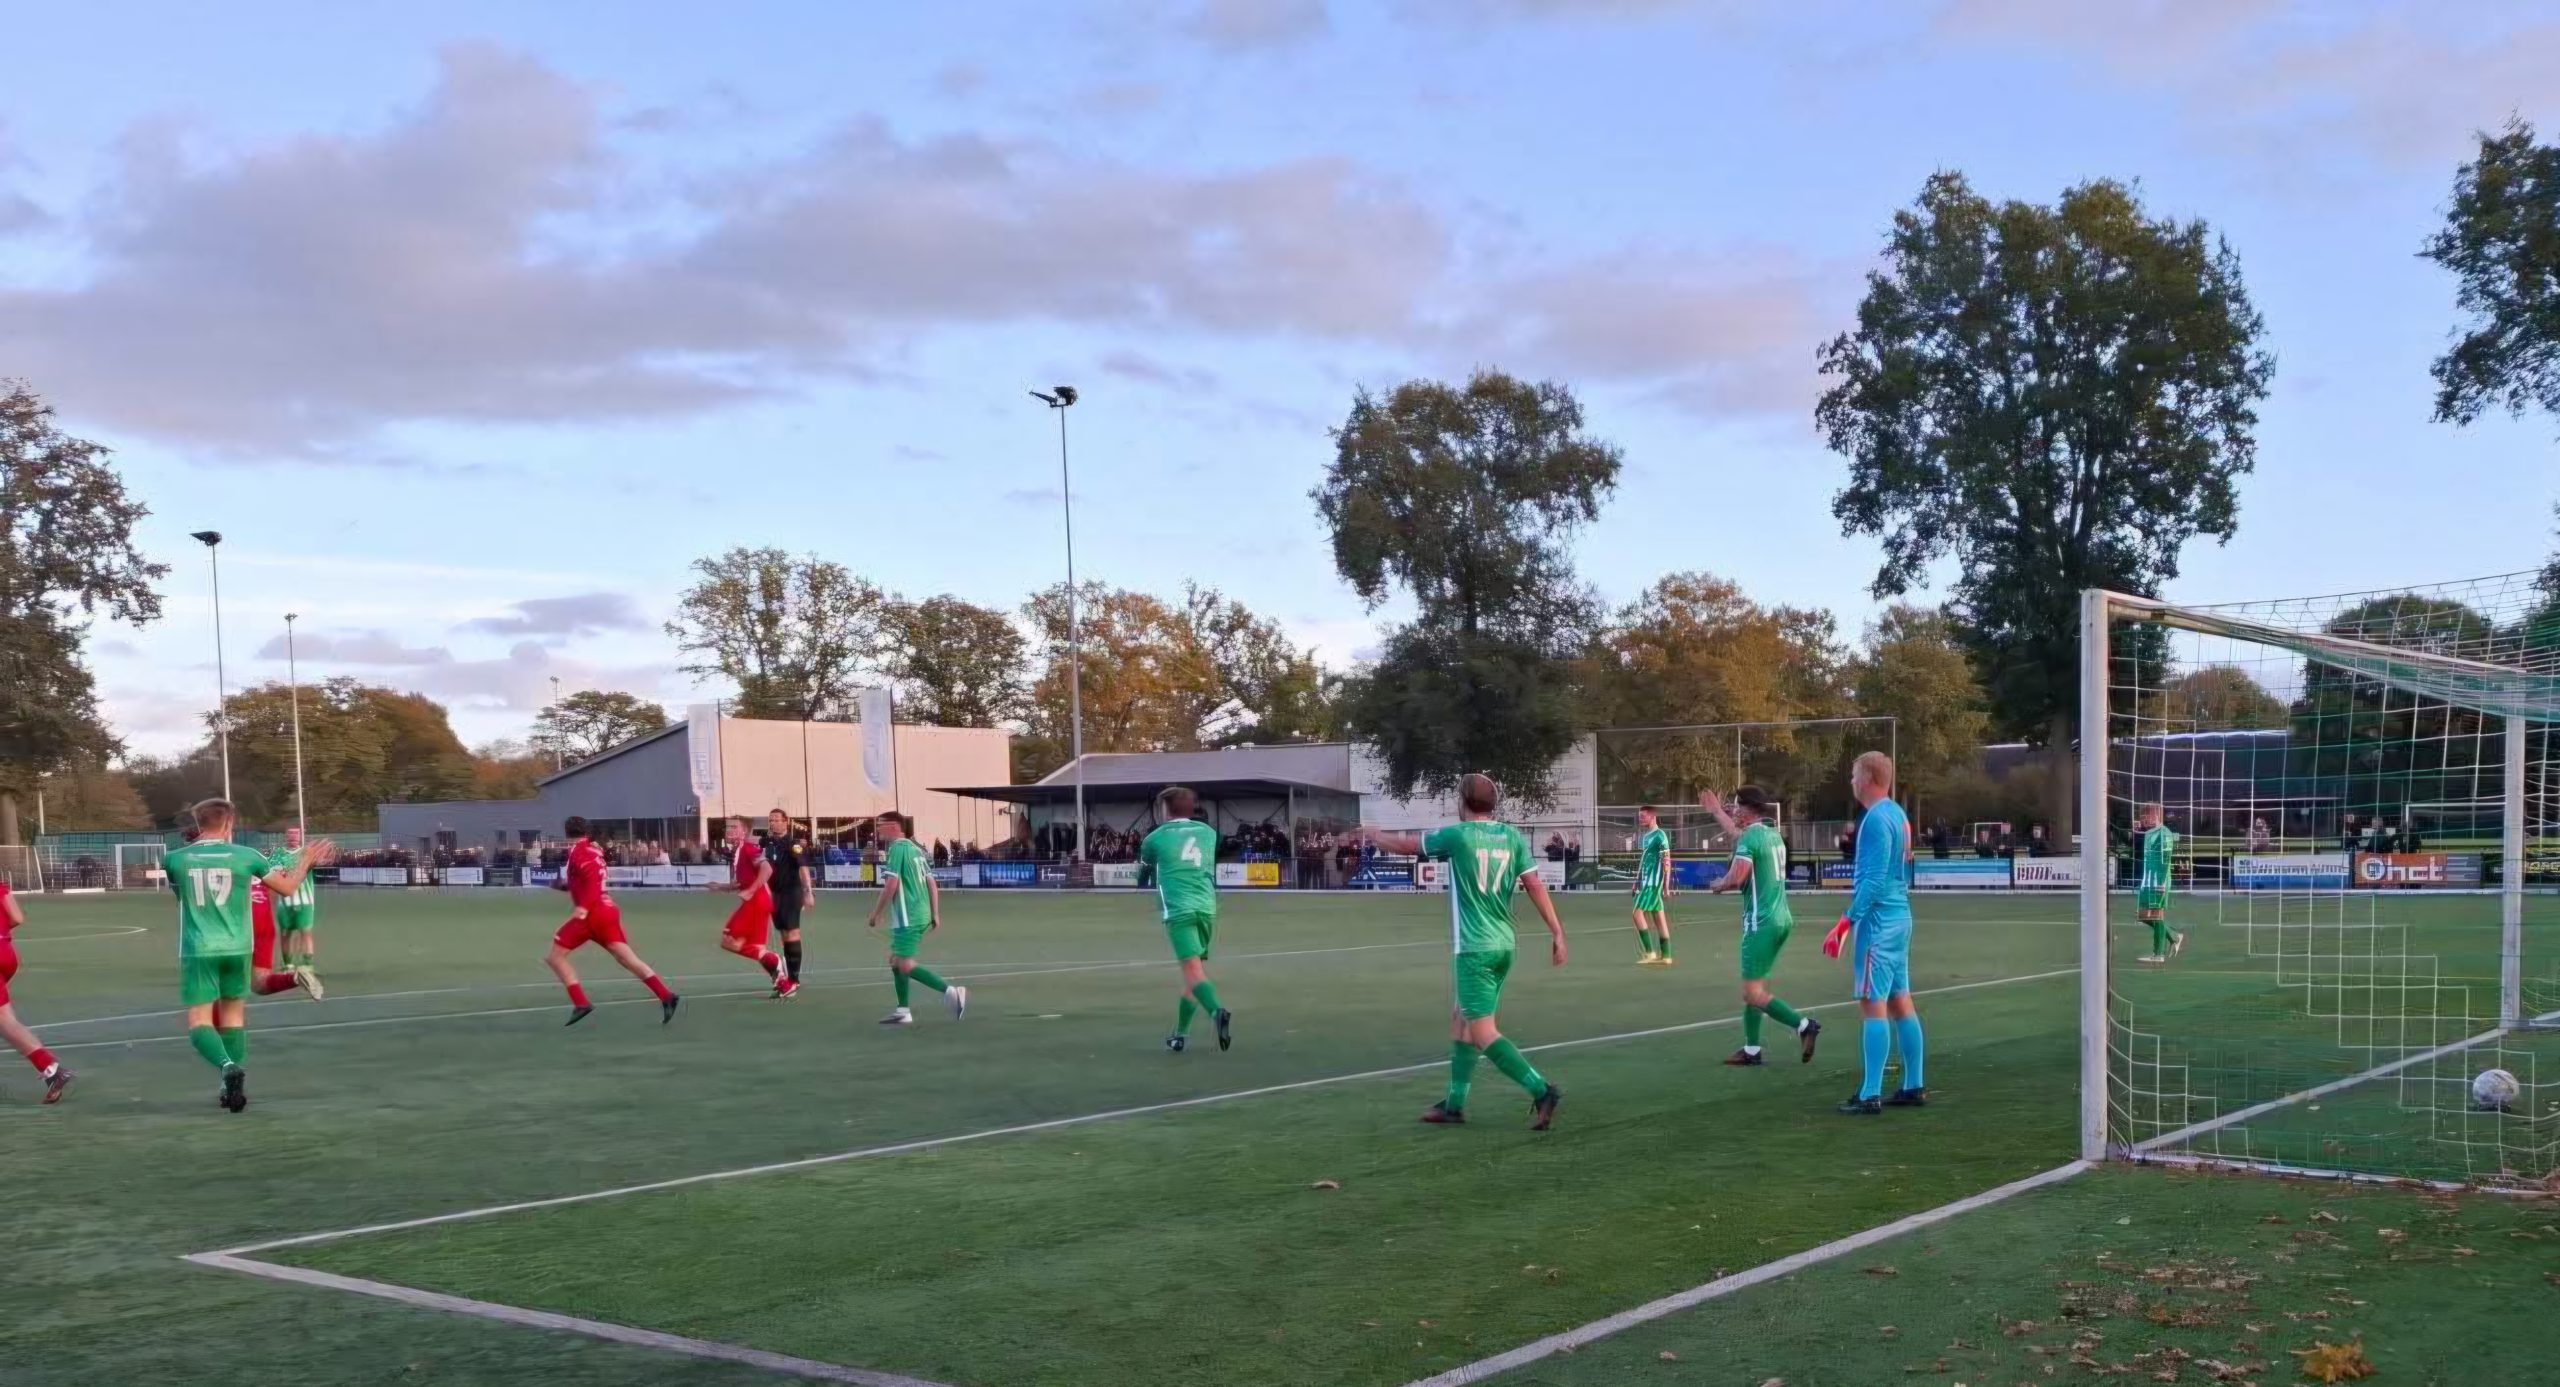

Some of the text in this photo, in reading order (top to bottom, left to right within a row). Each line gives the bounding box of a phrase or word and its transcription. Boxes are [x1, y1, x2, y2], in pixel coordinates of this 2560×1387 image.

[1181, 836, 1202, 868] 4
[1475, 848, 1510, 895] 17
[188, 868, 232, 907] 19
